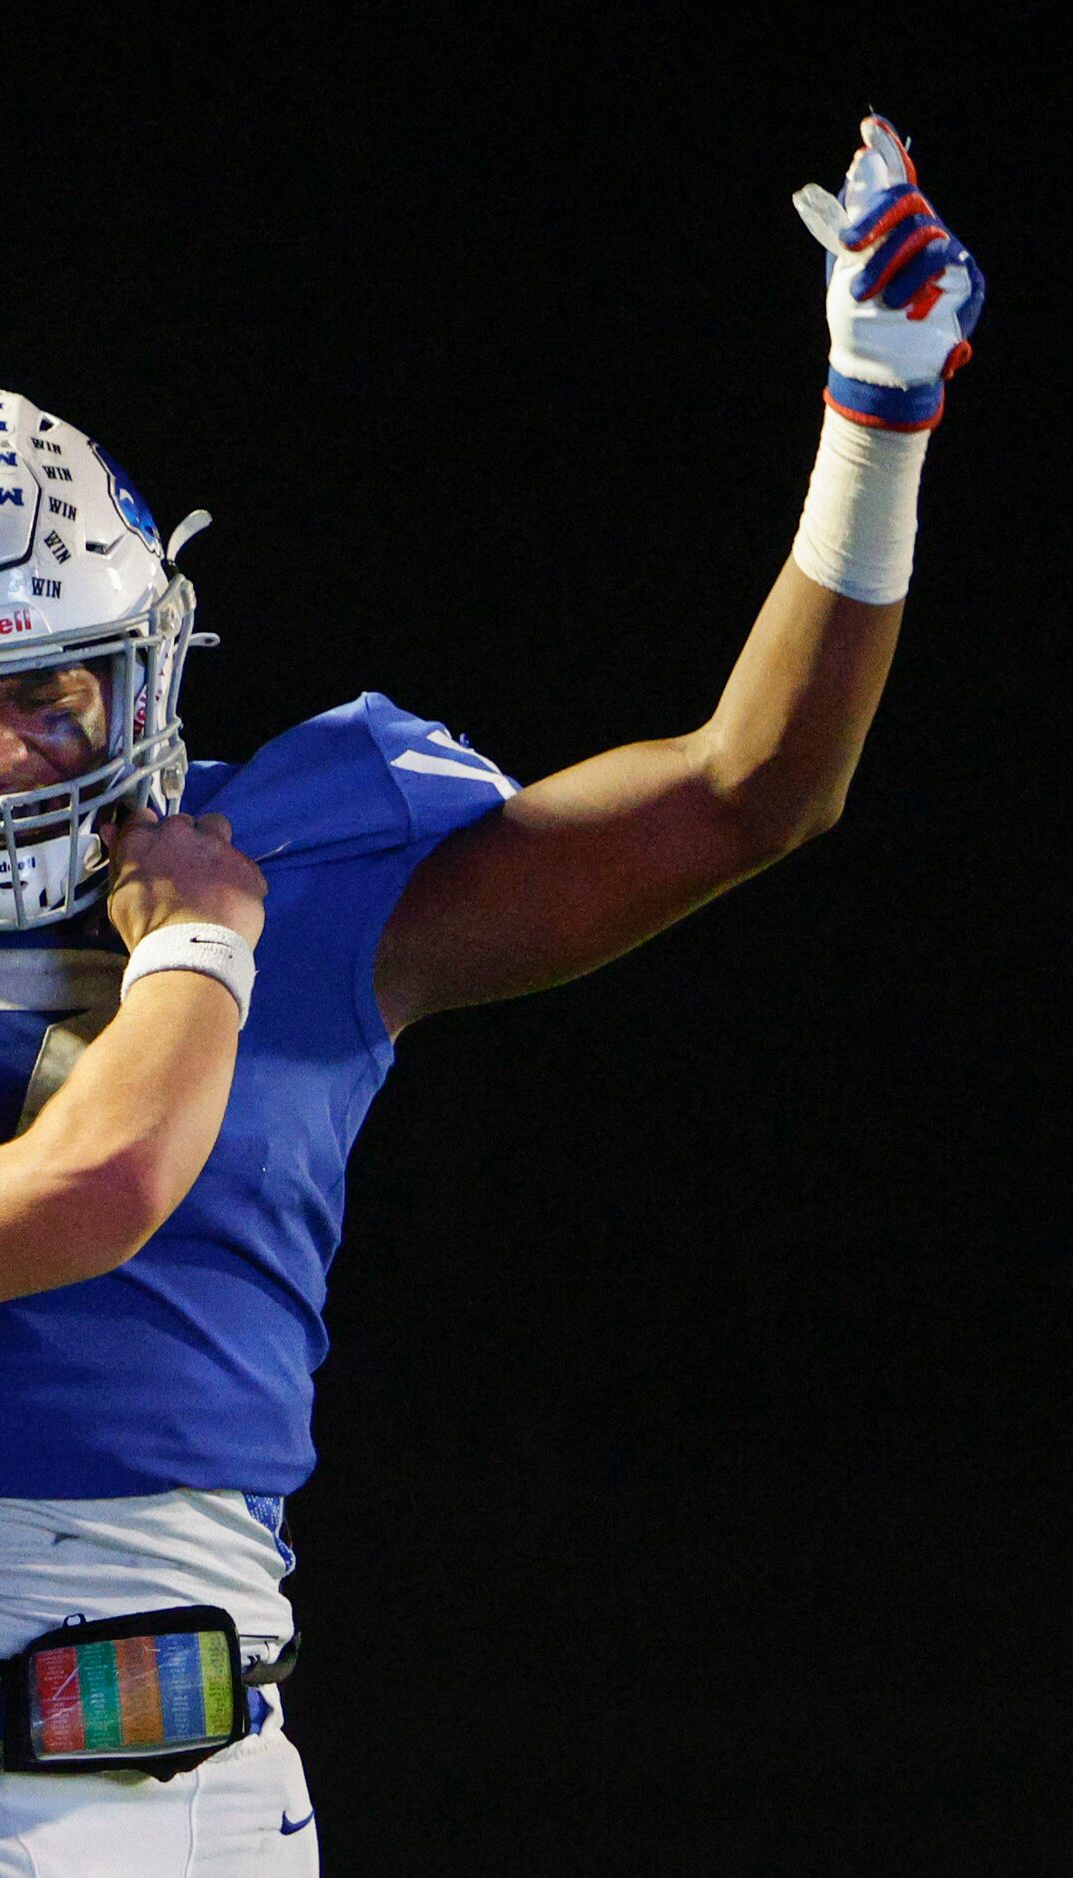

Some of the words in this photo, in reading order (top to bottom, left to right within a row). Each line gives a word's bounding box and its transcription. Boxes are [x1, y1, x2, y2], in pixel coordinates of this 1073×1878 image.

[31, 437, 62, 455] WIN
[42, 465, 73, 482] WIN
[48, 496, 78, 522] WIN
[43, 530, 72, 565] WIN
[31, 576, 62, 599] WIN
